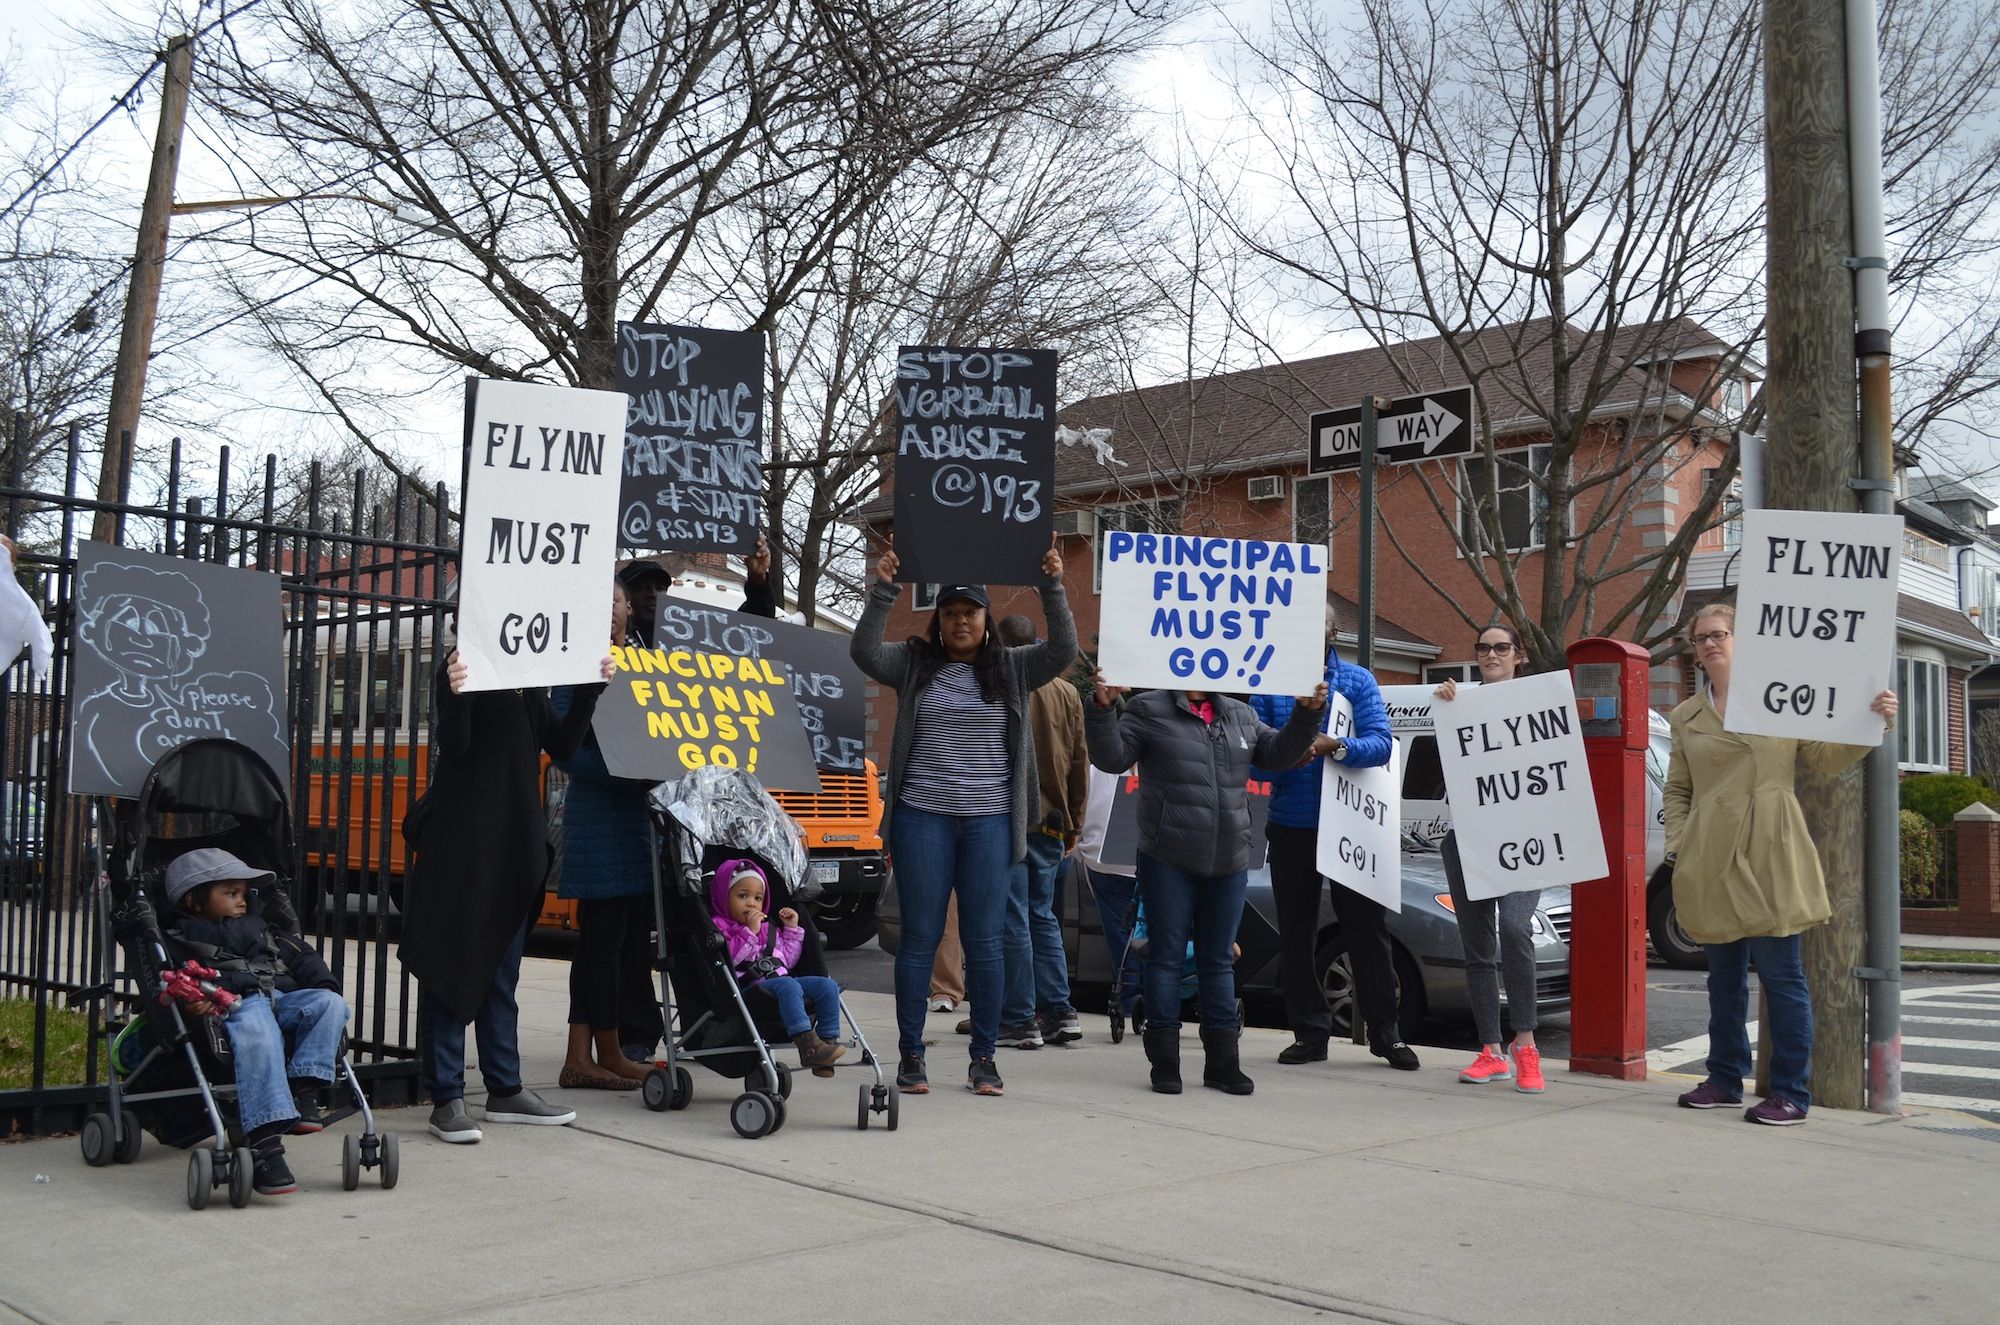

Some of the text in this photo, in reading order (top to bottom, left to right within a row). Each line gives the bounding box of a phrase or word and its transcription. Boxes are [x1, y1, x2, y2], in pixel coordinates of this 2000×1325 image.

[622, 324, 701, 386] STOP
[896, 351, 1033, 384] STOP
[484, 421, 606, 475] FLYNN
[898, 424, 1027, 464] ABUSE
[1332, 412, 1445, 452] ON WAY
[623, 431, 763, 490] PARENTS
[486, 517, 590, 565] MUST
[1109, 531, 1322, 575] PRINCIPAL
[1766, 536, 1891, 579] FLYNN
[1153, 570, 1293, 607] FLYNN
[499, 612, 569, 655] GO!
[661, 605, 774, 659] STOP
[1151, 607, 1271, 641] MUST
[1757, 603, 1866, 643] MUST
[610, 644, 785, 685] RINCIPAL
[1168, 644, 1275, 687] GO!!
[630, 679, 775, 716] FLYNN
[1763, 681, 1836, 719] GO!
[647, 711, 761, 743] MUST
[1456, 705, 1571, 757] FLYNN
[678, 742, 758, 773] GO!
[1336, 775, 1388, 827] MUST
[1475, 760, 1567, 807] MUST
[1339, 836, 1376, 878] GO!
[1498, 832, 1565, 871] GO!
